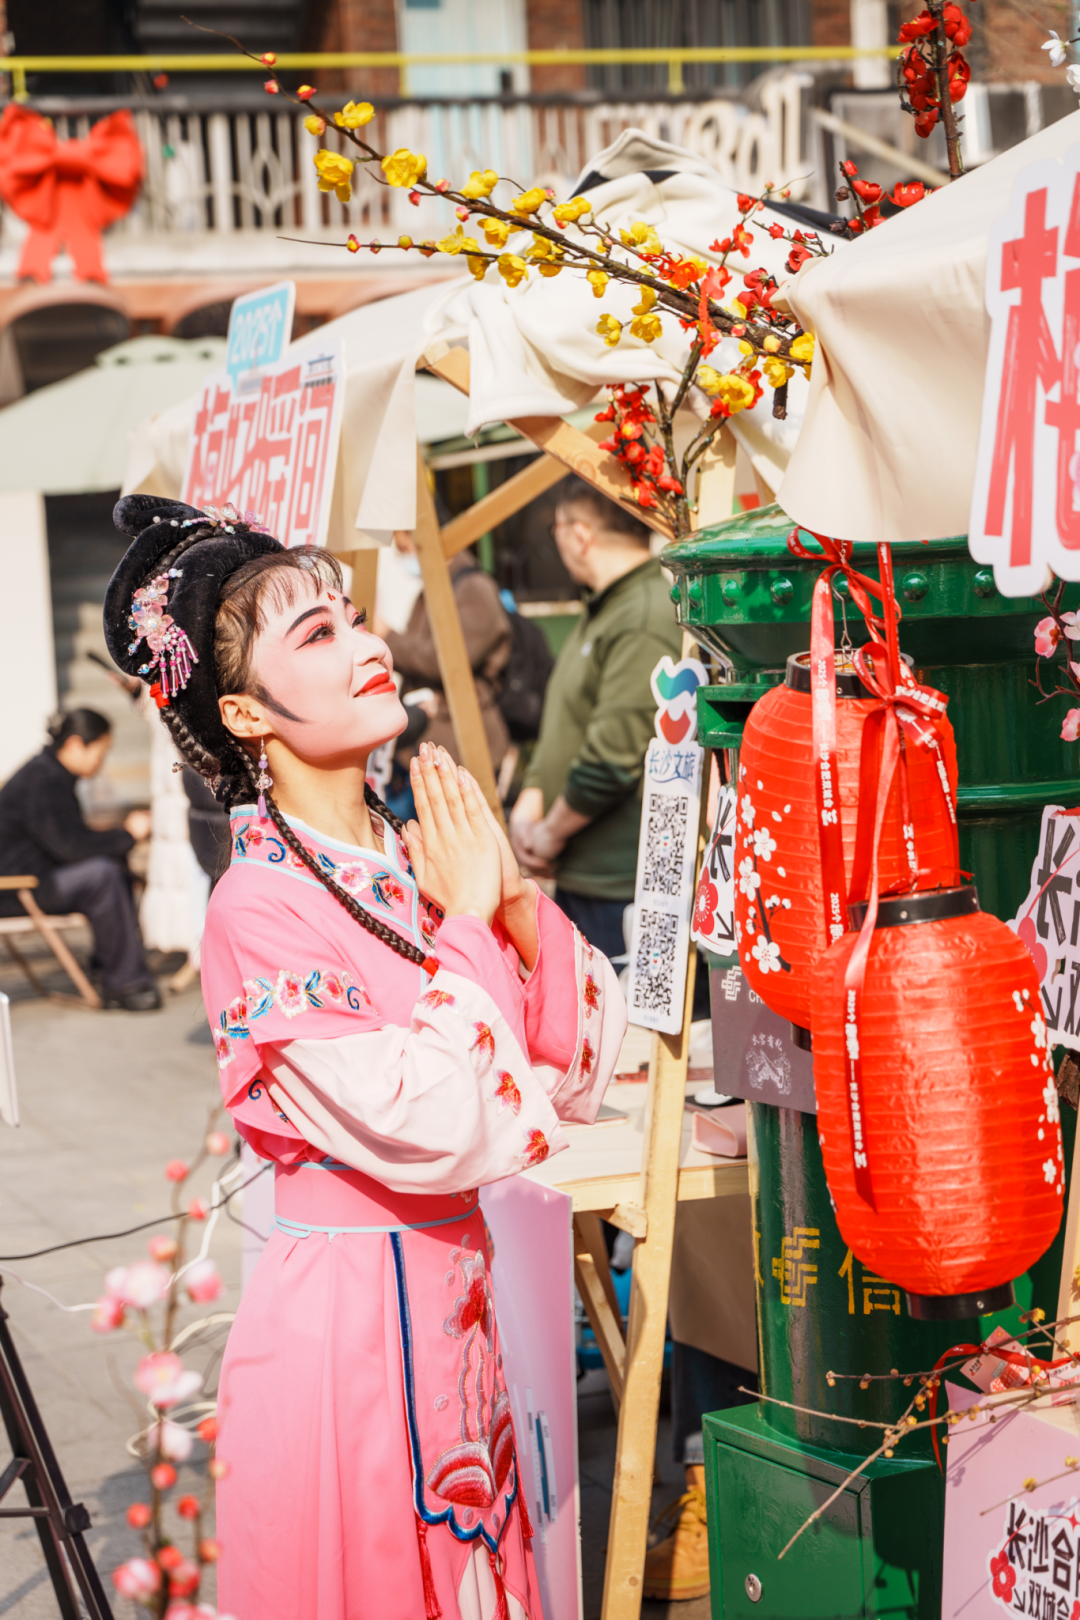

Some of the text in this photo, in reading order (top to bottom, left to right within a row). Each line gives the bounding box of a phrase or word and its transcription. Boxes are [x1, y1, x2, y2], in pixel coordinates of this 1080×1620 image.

[648, 749, 697, 781] 长沙文旅
[1007, 1502, 1080, 1598] 长沙合
